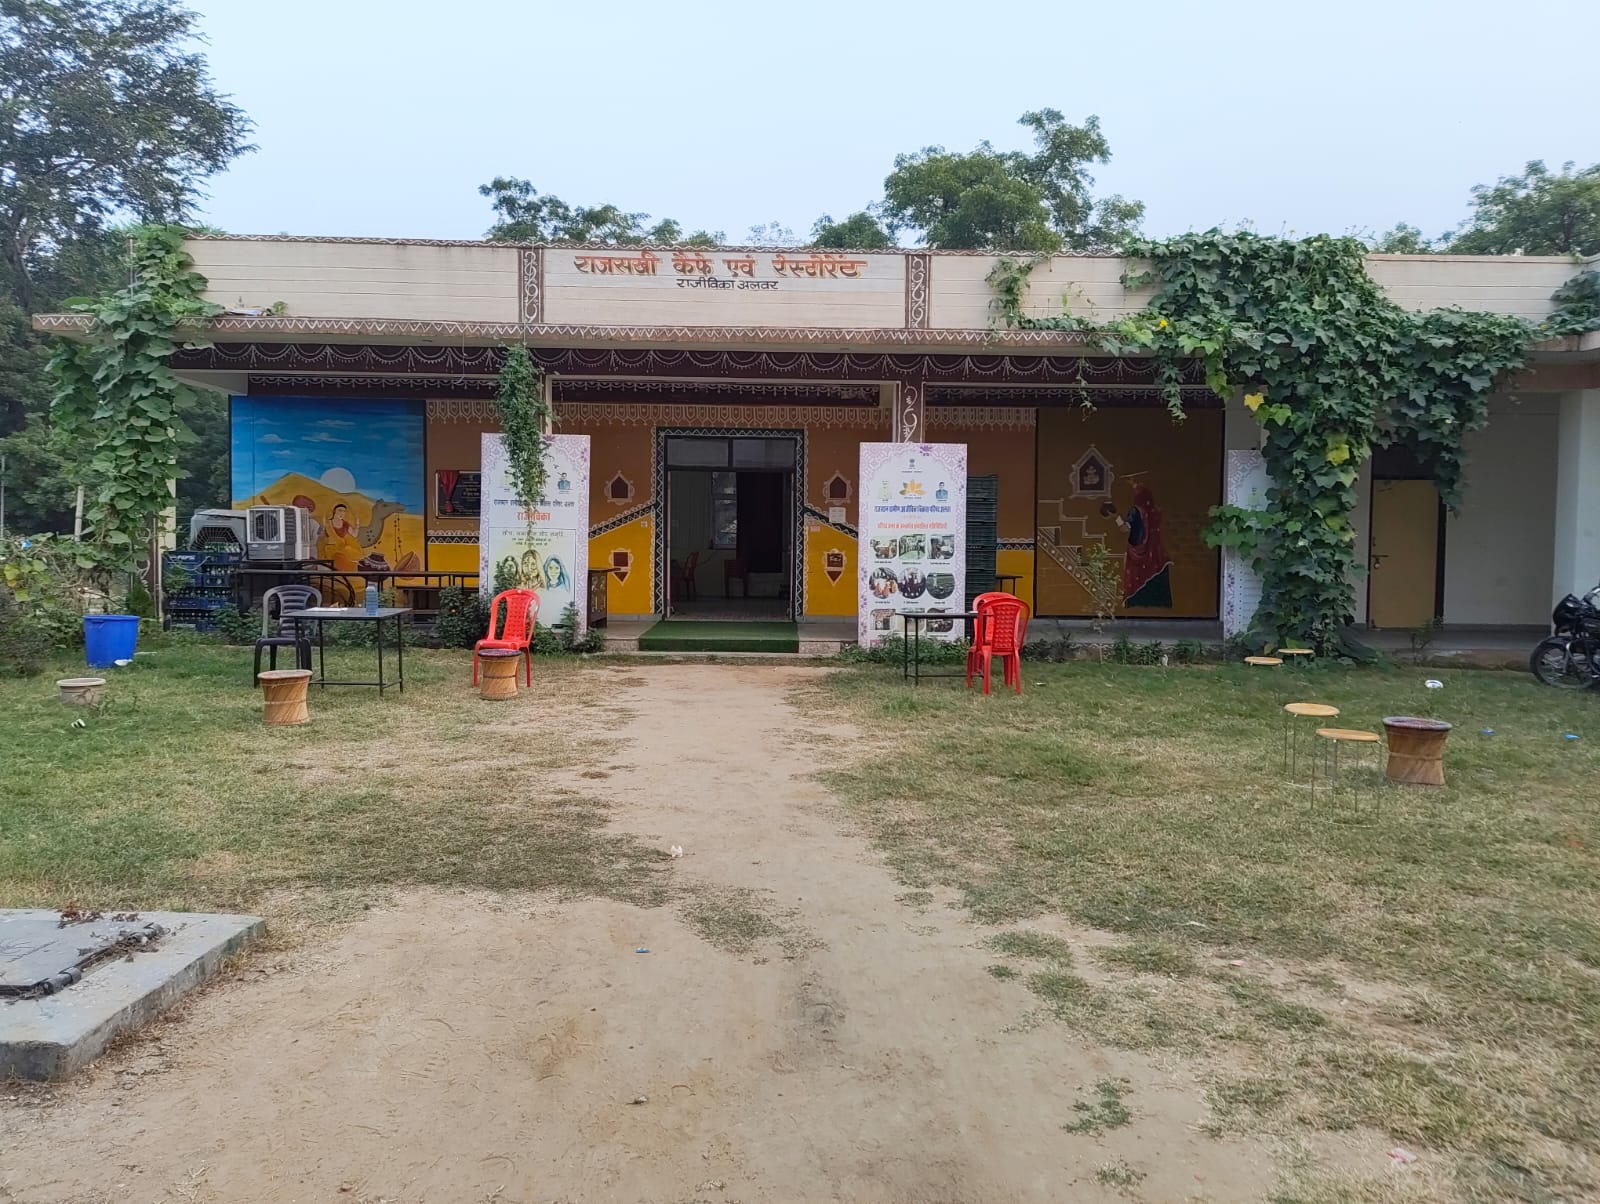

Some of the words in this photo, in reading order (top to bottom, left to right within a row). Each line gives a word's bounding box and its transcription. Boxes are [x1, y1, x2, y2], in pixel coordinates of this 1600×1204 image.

[574, 251, 663, 276] राजसखी
[722, 254, 757, 277] एवं
[676, 277, 735, 290] राजीविका
[737, 279, 779, 291] अलवर
